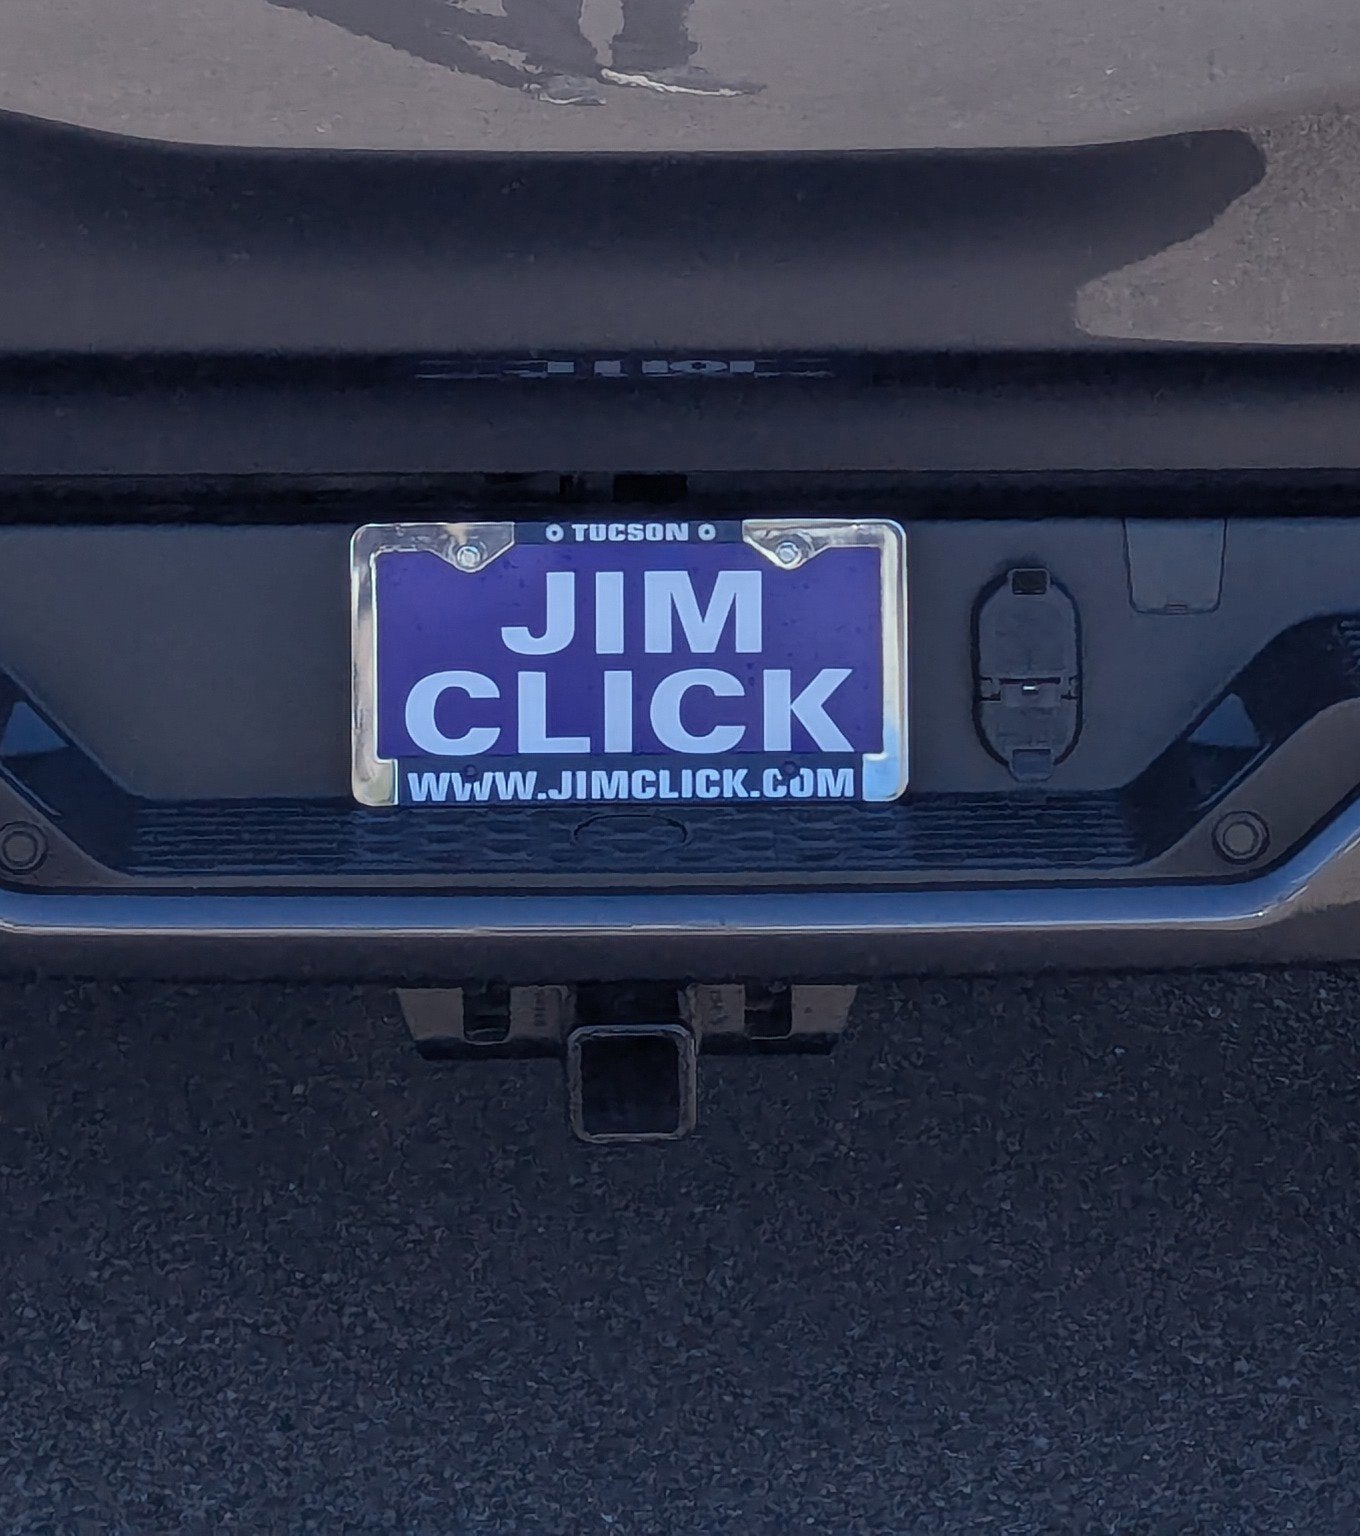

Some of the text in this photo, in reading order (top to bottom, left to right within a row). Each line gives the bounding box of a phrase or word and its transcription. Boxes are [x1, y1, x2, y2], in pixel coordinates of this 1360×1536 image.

[571, 522, 689, 542] TUCSON
[500, 569, 763, 656] JIM
[404, 668, 855, 755] CLICK
[407, 767, 855, 802] WWW.JIMCLICK.COM
